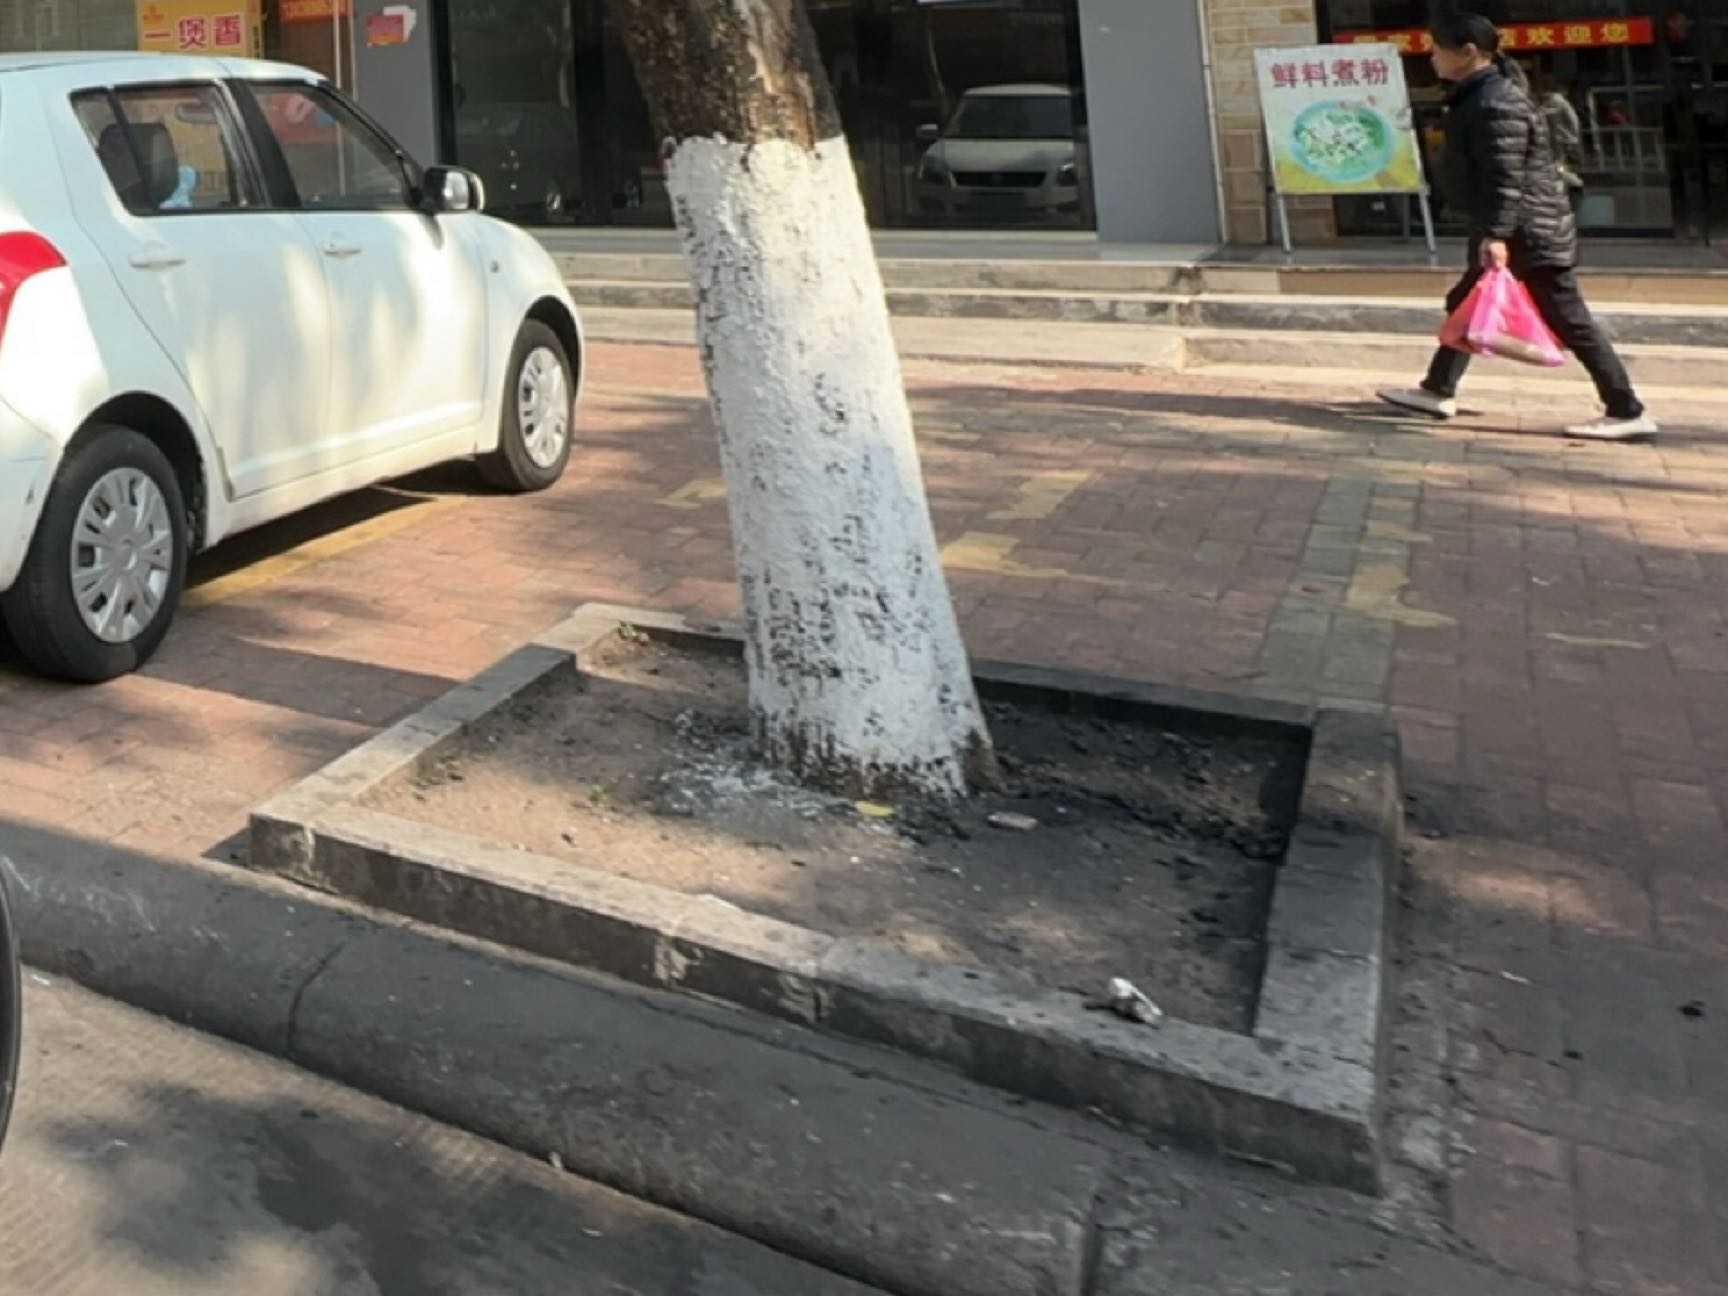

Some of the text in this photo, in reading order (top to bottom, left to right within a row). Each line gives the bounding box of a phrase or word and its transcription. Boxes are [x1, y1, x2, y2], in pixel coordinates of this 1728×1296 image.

[144, 13, 240, 49] 一煲香
[1271, 57, 1389, 88] 鲜料煮粉
